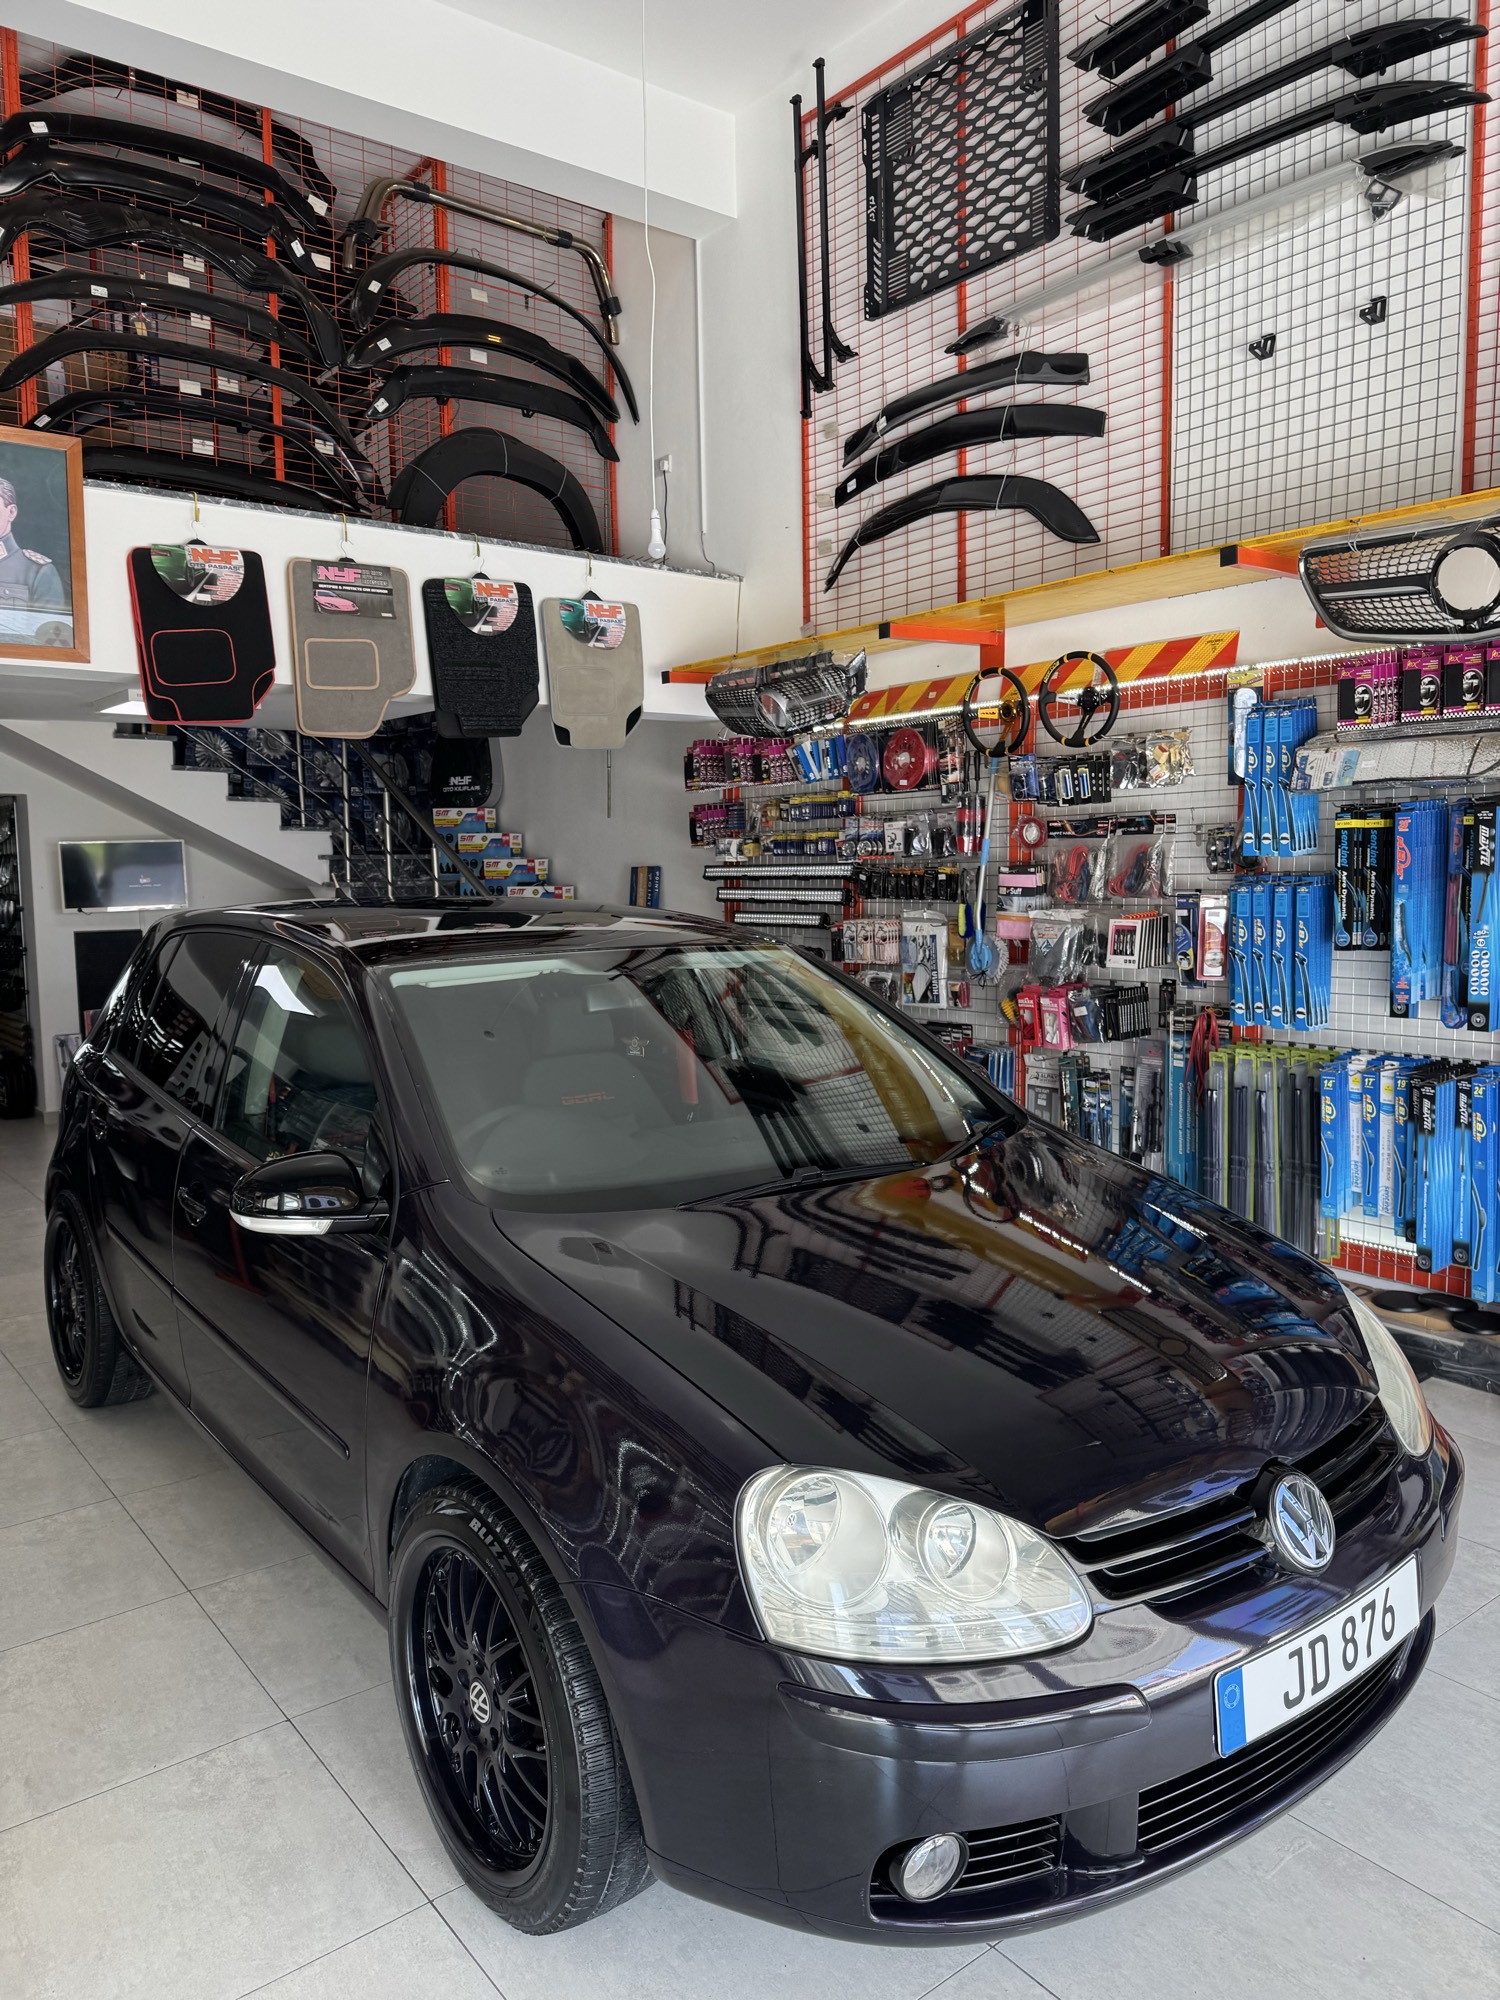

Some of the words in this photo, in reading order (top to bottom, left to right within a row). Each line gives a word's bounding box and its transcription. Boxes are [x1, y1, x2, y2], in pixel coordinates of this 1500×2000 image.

[468, 1517, 531, 1605] BLIZZAK
[1283, 1634, 1330, 1710] JD
[1341, 1587, 1396, 1672] 876
